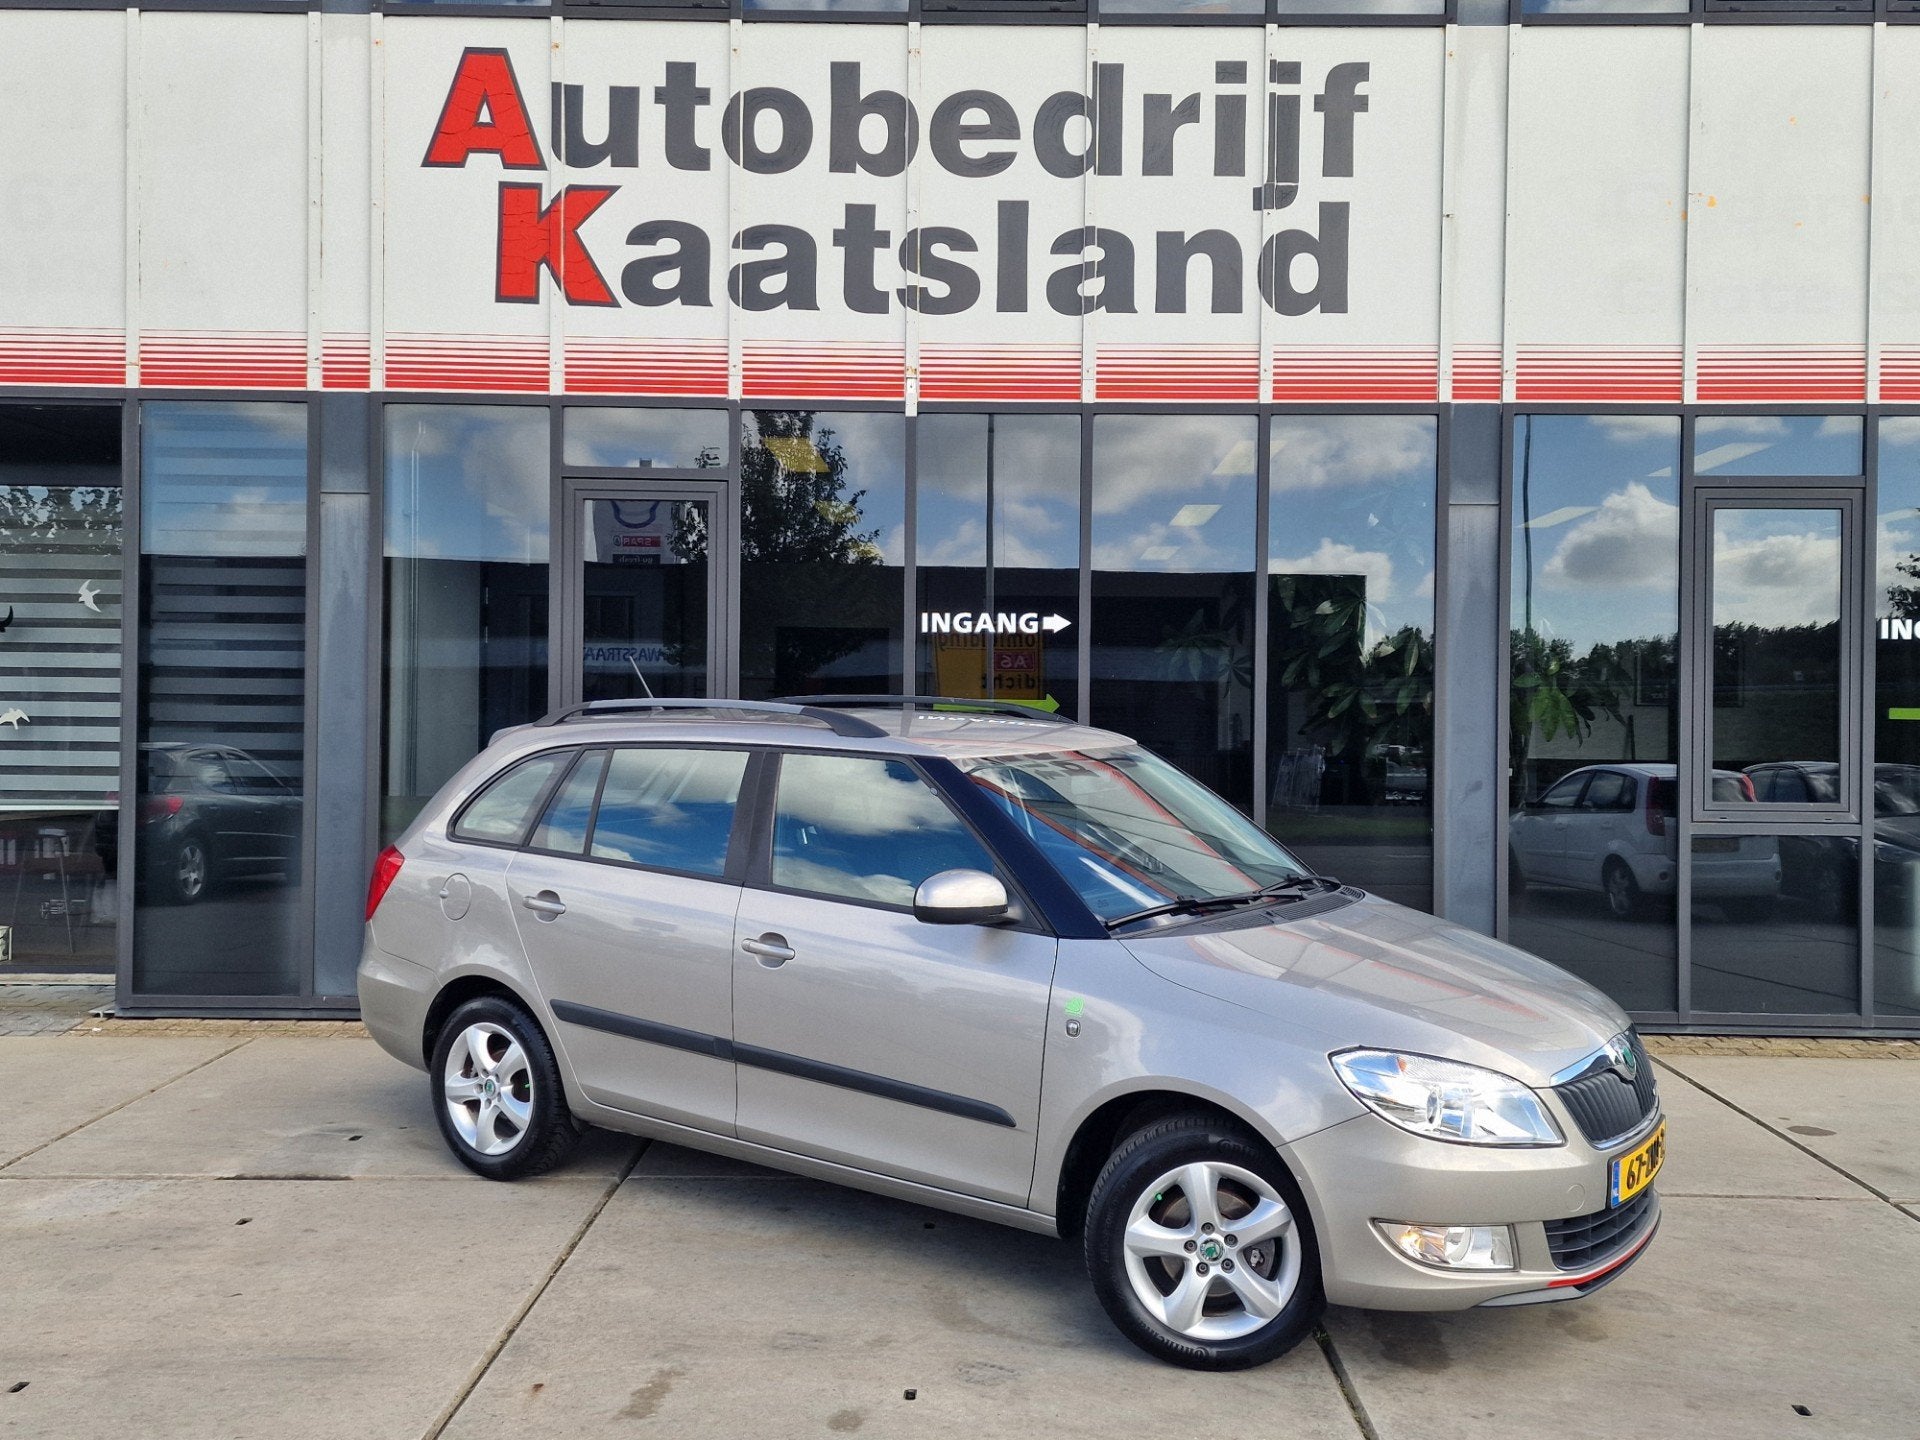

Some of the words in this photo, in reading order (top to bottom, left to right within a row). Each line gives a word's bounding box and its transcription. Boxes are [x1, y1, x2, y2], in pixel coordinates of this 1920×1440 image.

[420, 47, 1370, 211] Autobedrijf
[495, 181, 1350, 316] Kaatsland
[921, 612, 1039, 633] INGANG
